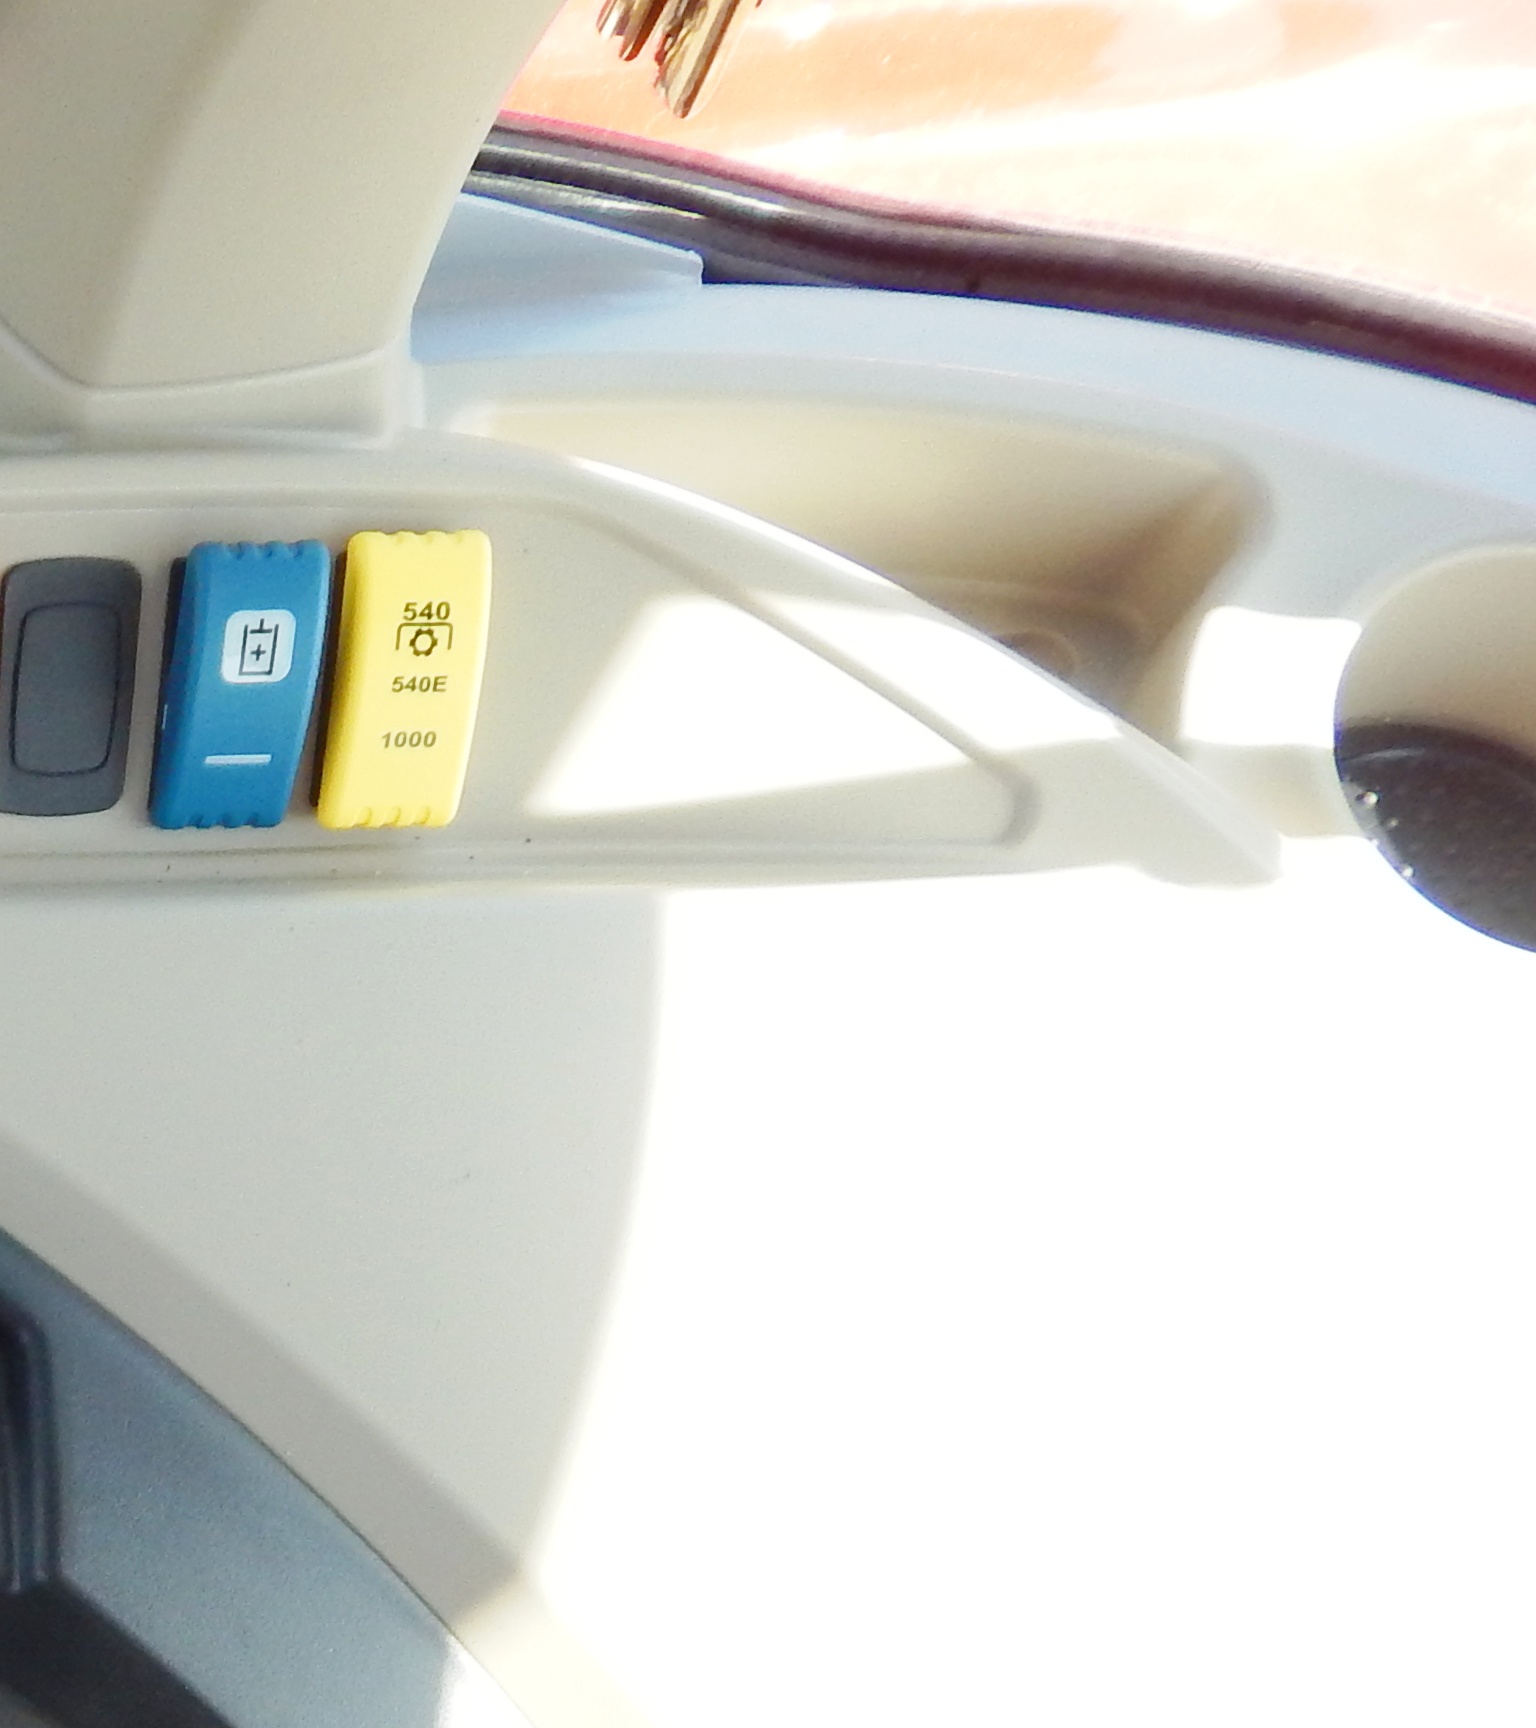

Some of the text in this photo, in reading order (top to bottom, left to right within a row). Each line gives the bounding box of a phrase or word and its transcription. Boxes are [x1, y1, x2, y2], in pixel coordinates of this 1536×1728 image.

[403, 601, 451, 621] 540
[390, 675, 448, 694] 540E
[380, 731, 438, 749] 1000
